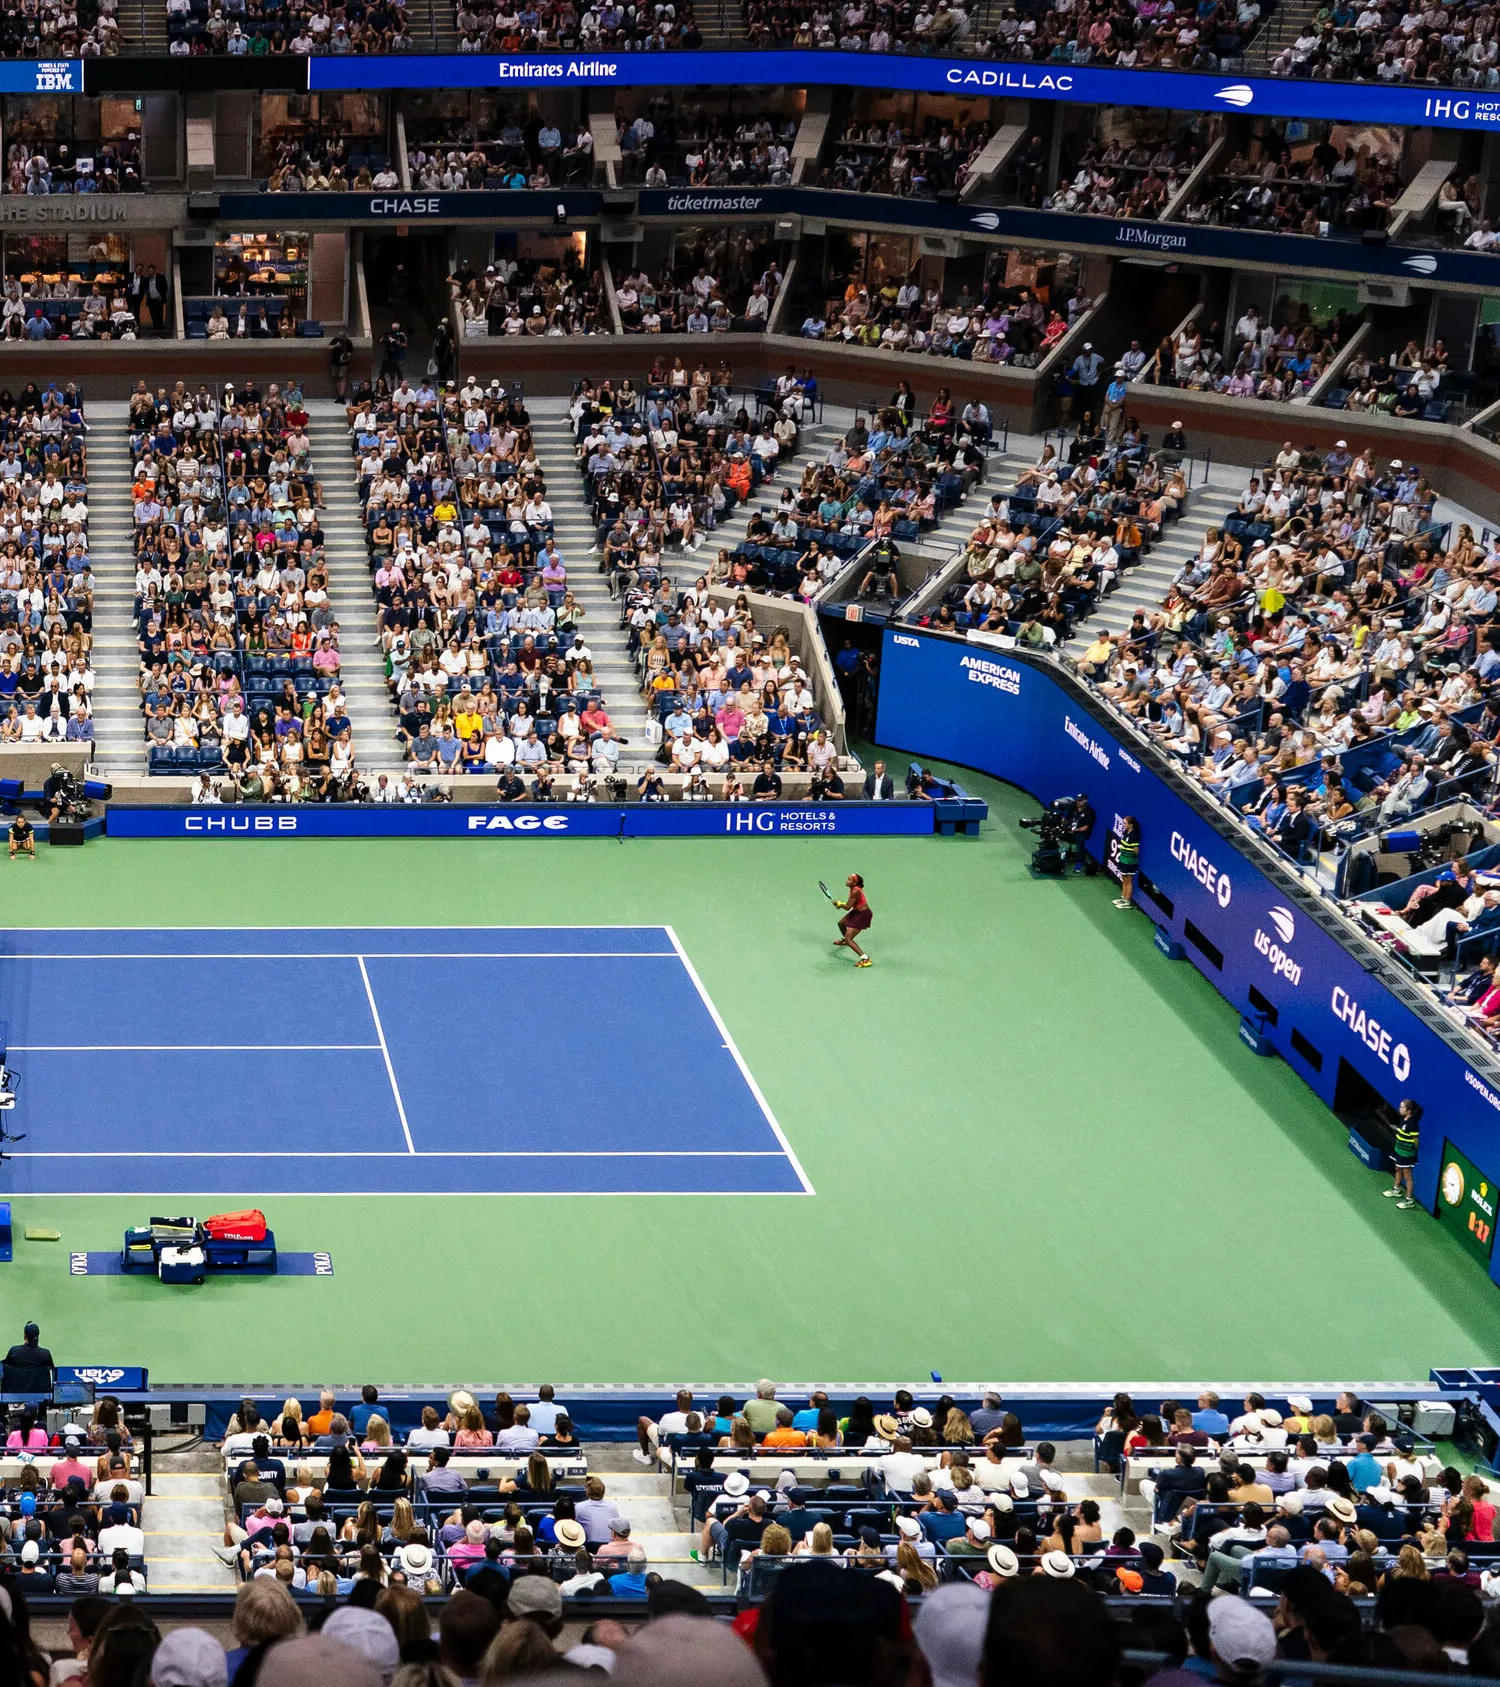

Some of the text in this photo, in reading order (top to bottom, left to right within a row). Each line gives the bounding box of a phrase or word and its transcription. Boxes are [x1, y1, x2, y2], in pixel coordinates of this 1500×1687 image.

[500, 62, 617, 78] Emirates Airline
[947, 69, 1073, 91] CADILLAC
[1425, 98, 1470, 120] IHG
[35, 204, 128, 221] STADIUM
[370, 198, 441, 213] CHASE
[667, 195, 763, 210] ticketmaster
[1116, 227, 1187, 250] J.P.Morgan
[893, 635, 920, 648] USTA
[960, 656, 1021, 683] AMERICAN
[968, 670, 1020, 695] EXPRESS
[1064, 715, 1110, 770] Emirates Airline
[185, 817, 297, 830] CHUBB
[468, 816, 569, 830] FAGE
[726, 812, 836, 831] IHG HOTELS &
[780, 822, 836, 831] RESORTS
[1170, 831, 1218, 895] CHASE
[1254, 928, 1301, 986] us open
[1332, 985, 1392, 1065] CHASE
[1471, 1189, 1492, 1216] ROLEX
[223, 1233, 254, 1241] Wilson
[71, 1252, 88, 1275] POLO
[315, 1253, 333, 1275] POLO
